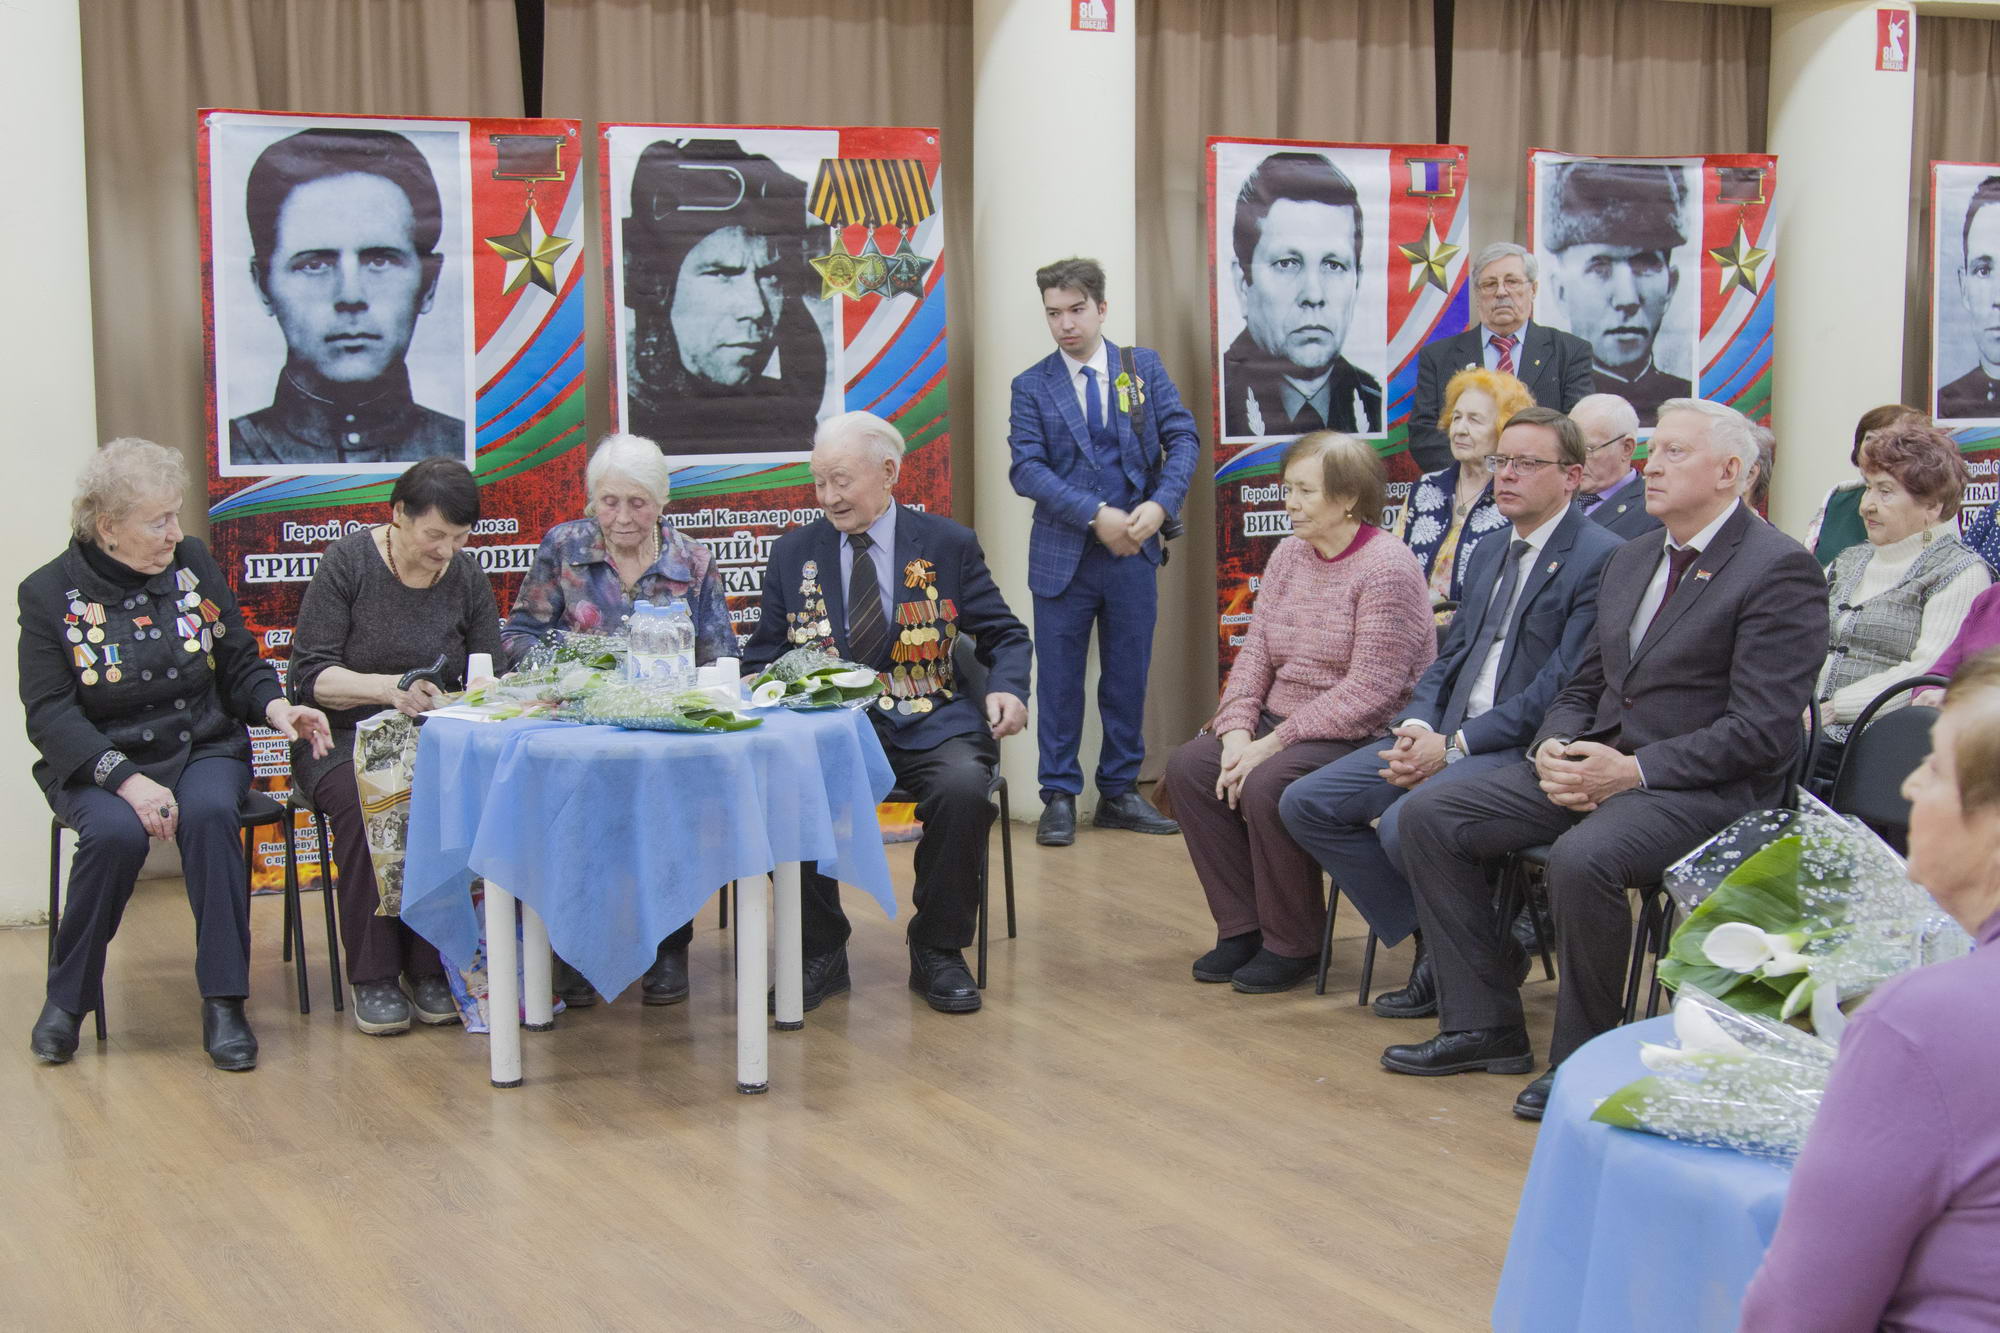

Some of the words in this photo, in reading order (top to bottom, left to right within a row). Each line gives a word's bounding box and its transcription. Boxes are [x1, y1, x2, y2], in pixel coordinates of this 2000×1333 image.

[1243, 485, 1278, 503] Герой
[472, 520, 517, 533] оюза
[667, 511, 711, 527] лный
[716, 510, 789, 526] Кавалер
[285, 521, 340, 542] Герой
[249, 557, 321, 579] ГРИГ
